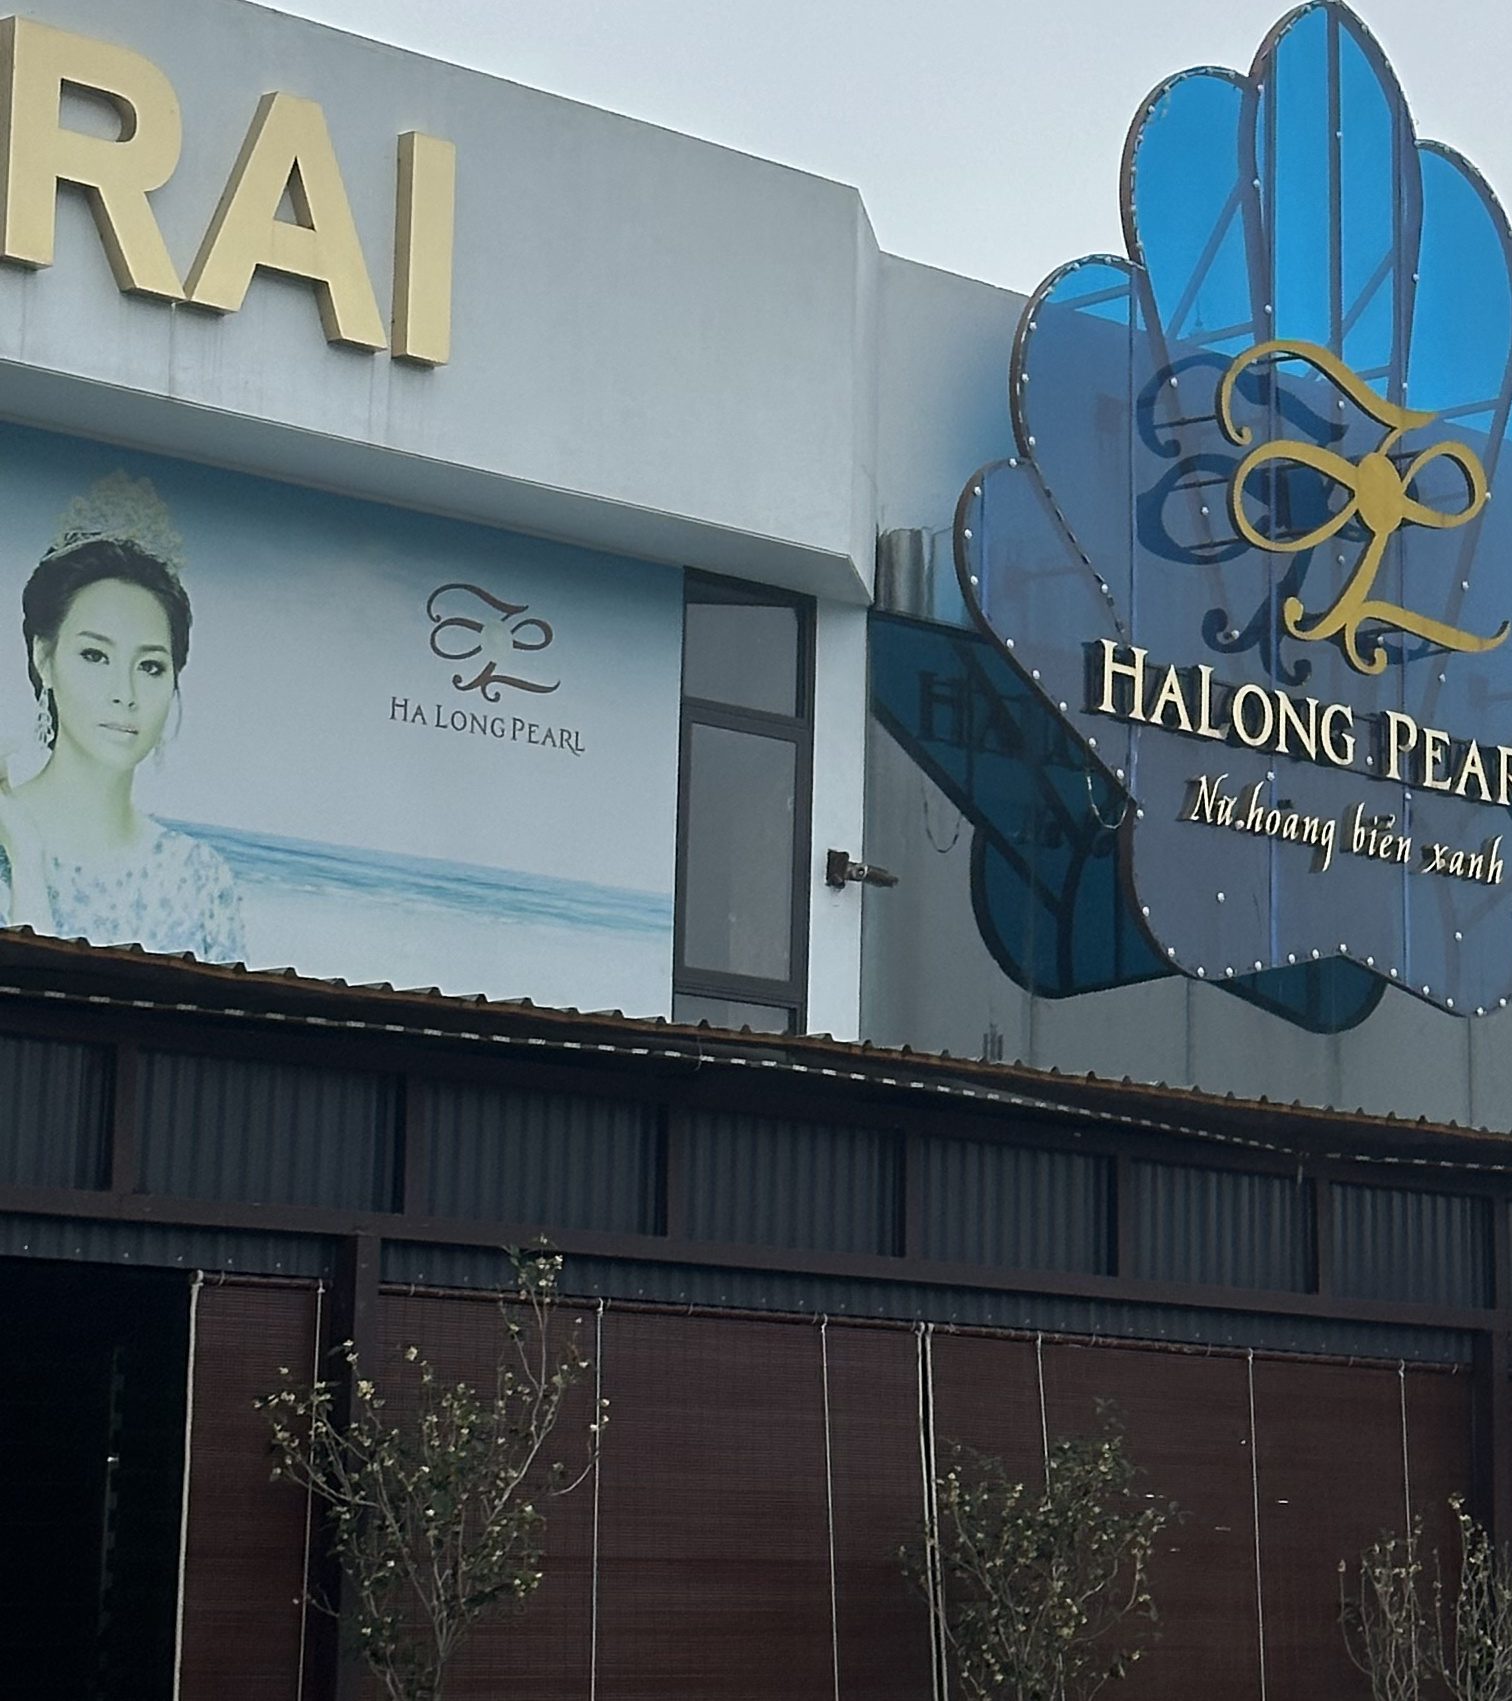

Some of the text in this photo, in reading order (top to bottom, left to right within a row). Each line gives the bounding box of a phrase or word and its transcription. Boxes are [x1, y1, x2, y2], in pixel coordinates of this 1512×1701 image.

[0, 15, 457, 367] RAI
[388, 696, 586, 758] HA LONG PEARL
[1420, 834, 1505, 885] xanh
